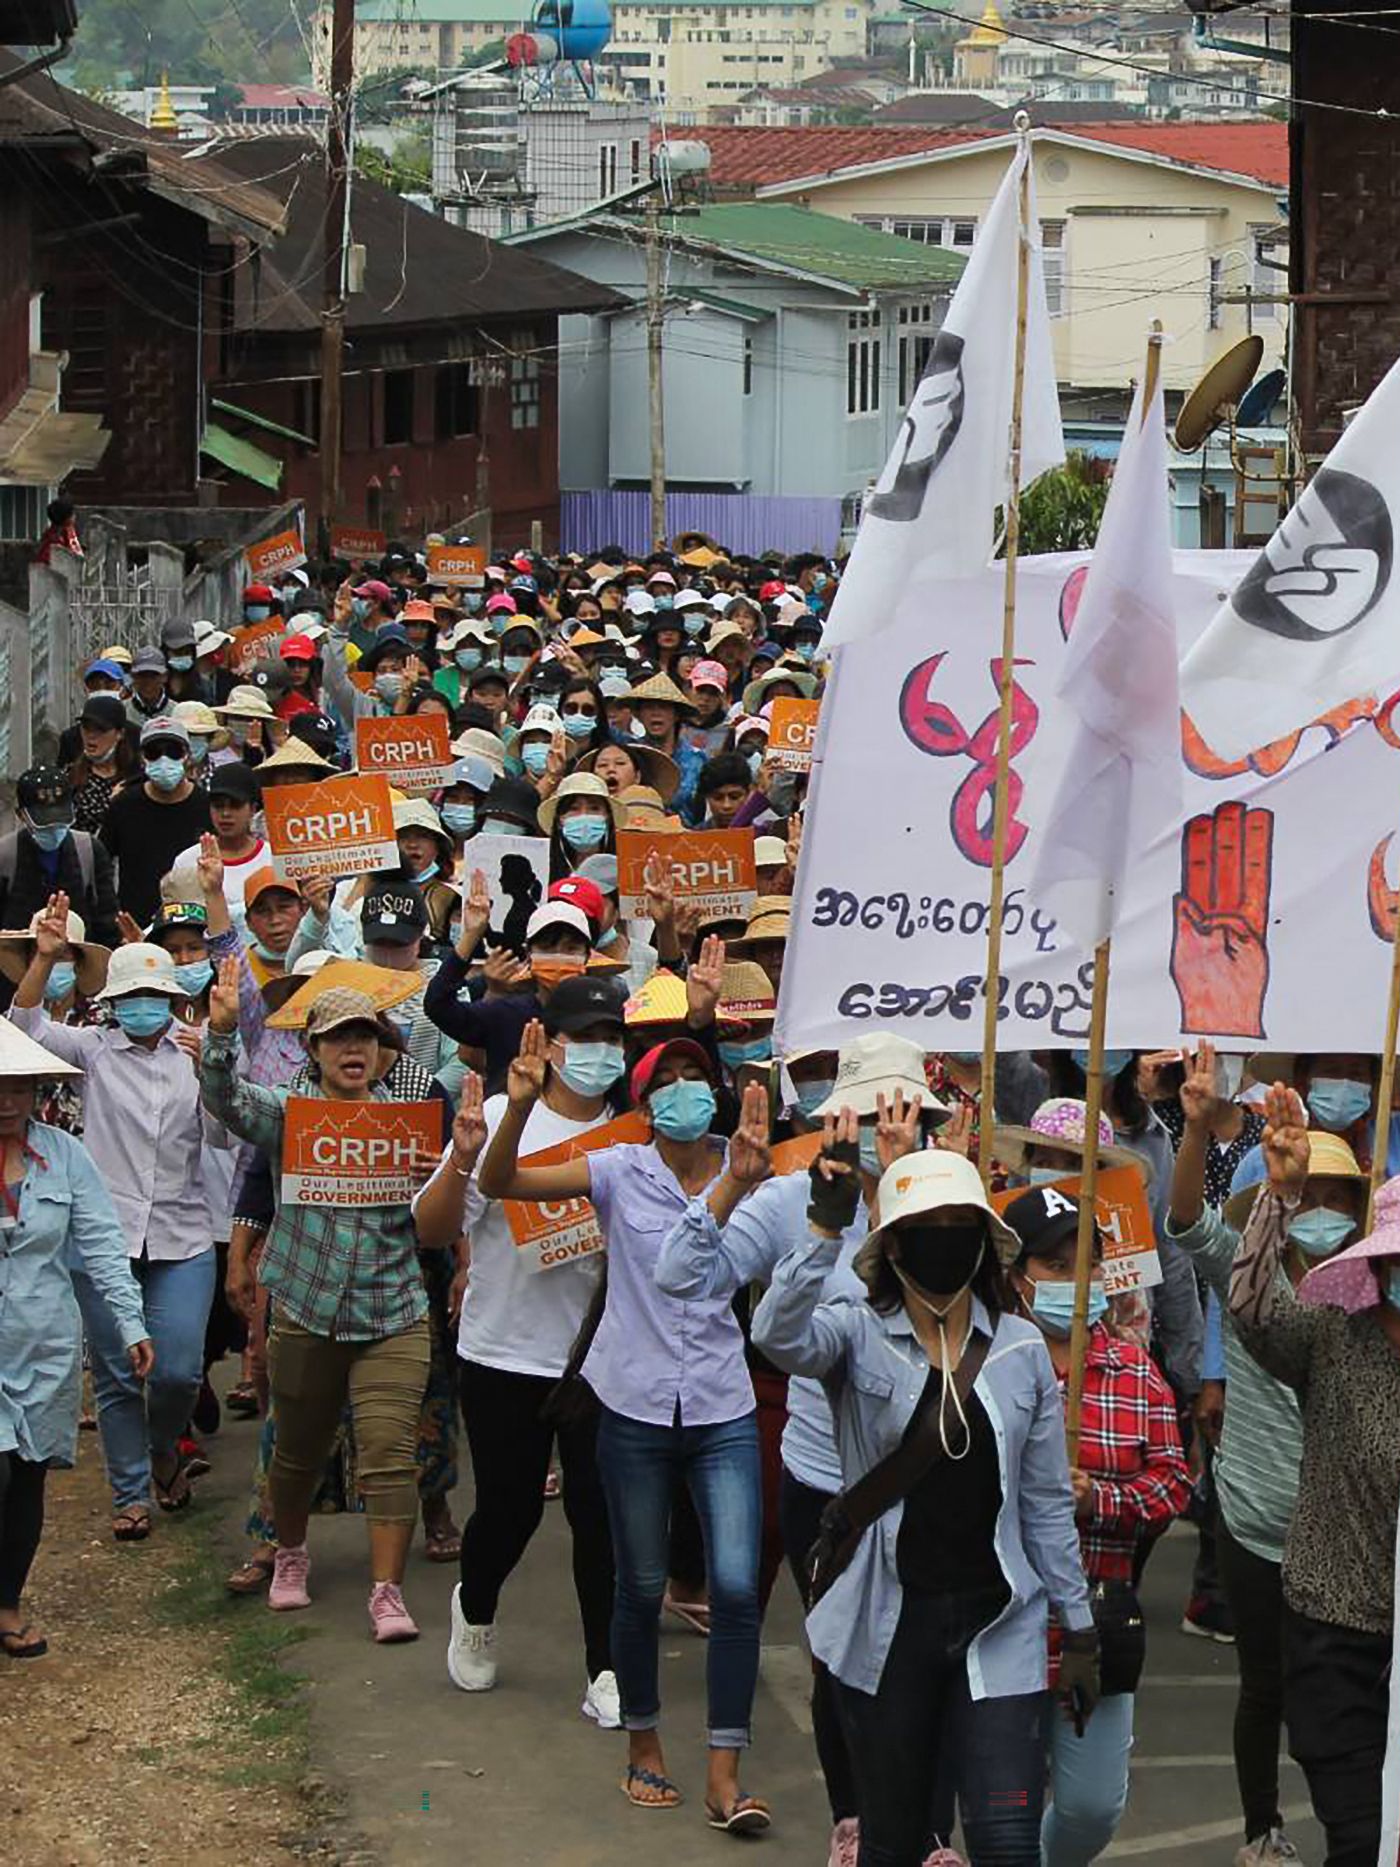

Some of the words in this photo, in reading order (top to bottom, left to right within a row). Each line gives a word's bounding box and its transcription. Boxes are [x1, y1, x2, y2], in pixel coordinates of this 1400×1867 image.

[259, 545, 295, 567] CRPH
[438, 559, 475, 572] CRPH
[787, 723, 818, 744] CR
[370, 739, 435, 762] CRPH
[286, 808, 372, 844] CRPH
[285, 857, 385, 878] GOVERNMENT
[312, 1136, 417, 1166] CRPH
[301, 1178, 328, 1189] Our
[298, 1190, 417, 1204] GOVERNMEN
[1041, 1187, 1078, 1218] A
[540, 1234, 568, 1250] Our
